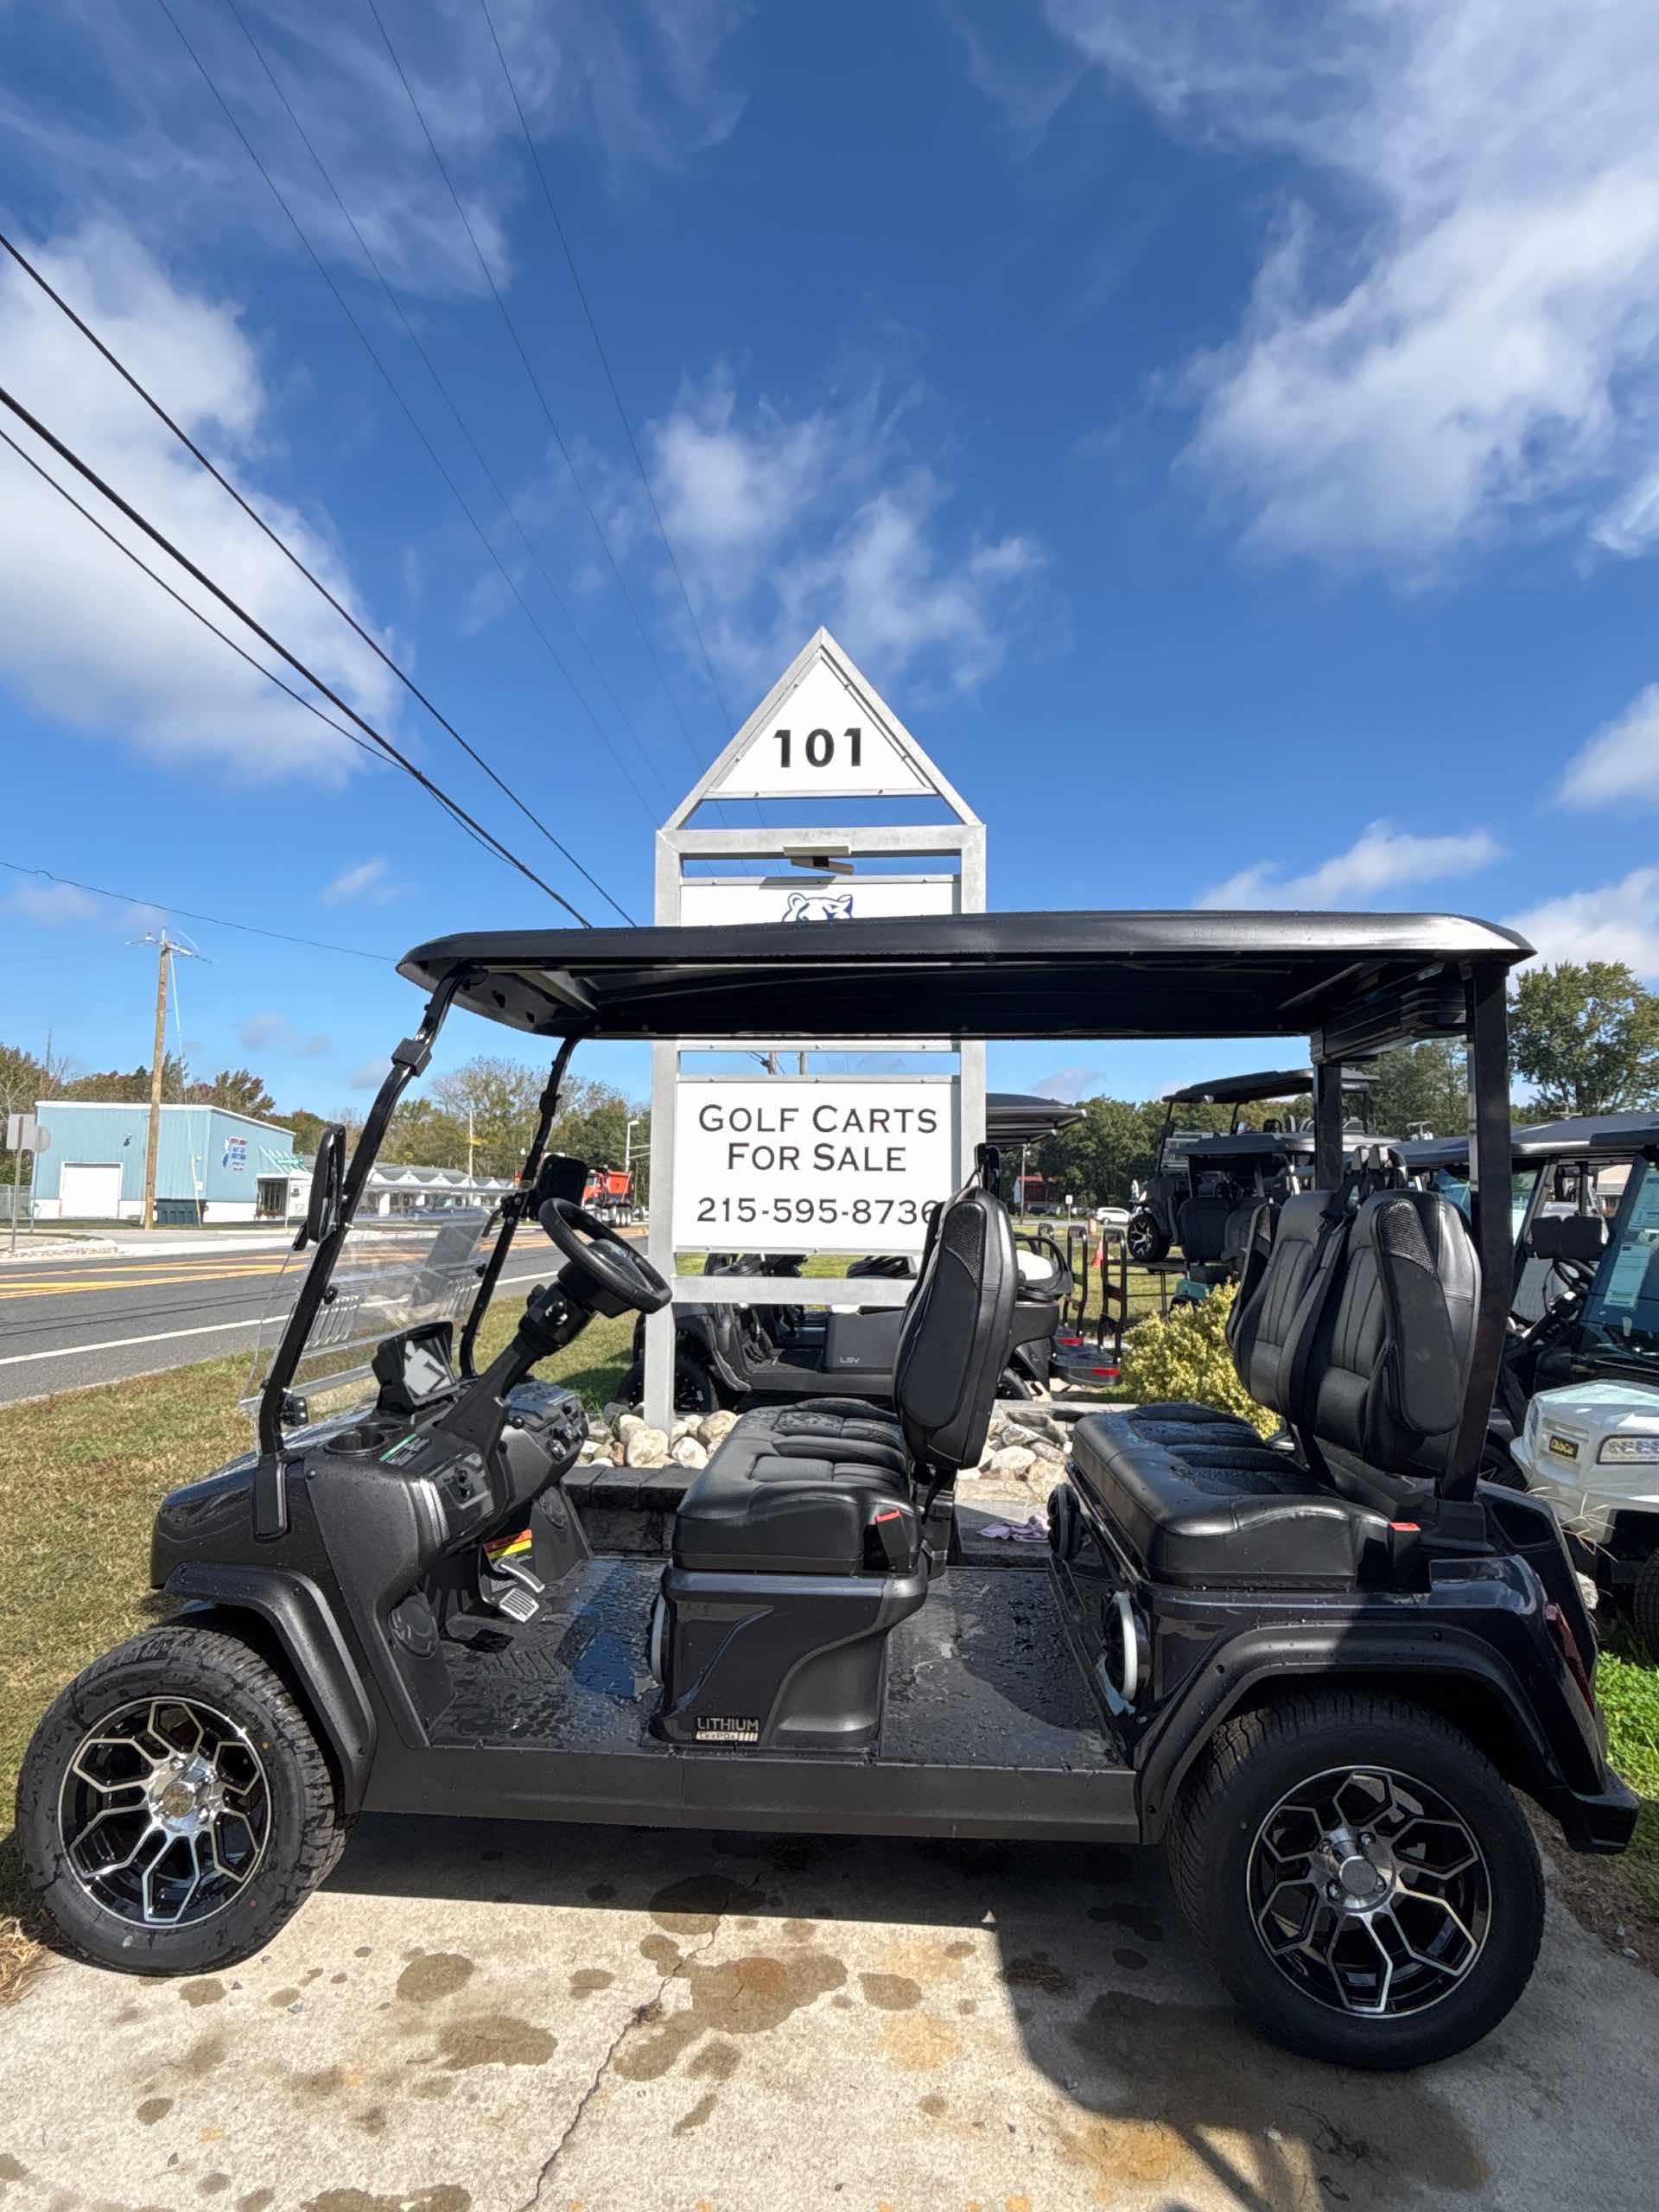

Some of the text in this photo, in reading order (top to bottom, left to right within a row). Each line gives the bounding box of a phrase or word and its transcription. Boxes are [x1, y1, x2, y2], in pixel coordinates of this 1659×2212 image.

[773, 728, 861, 768] 101
[699, 1103, 938, 1134] GOLF CARTS
[728, 1142, 906, 1172] FOR SALE
